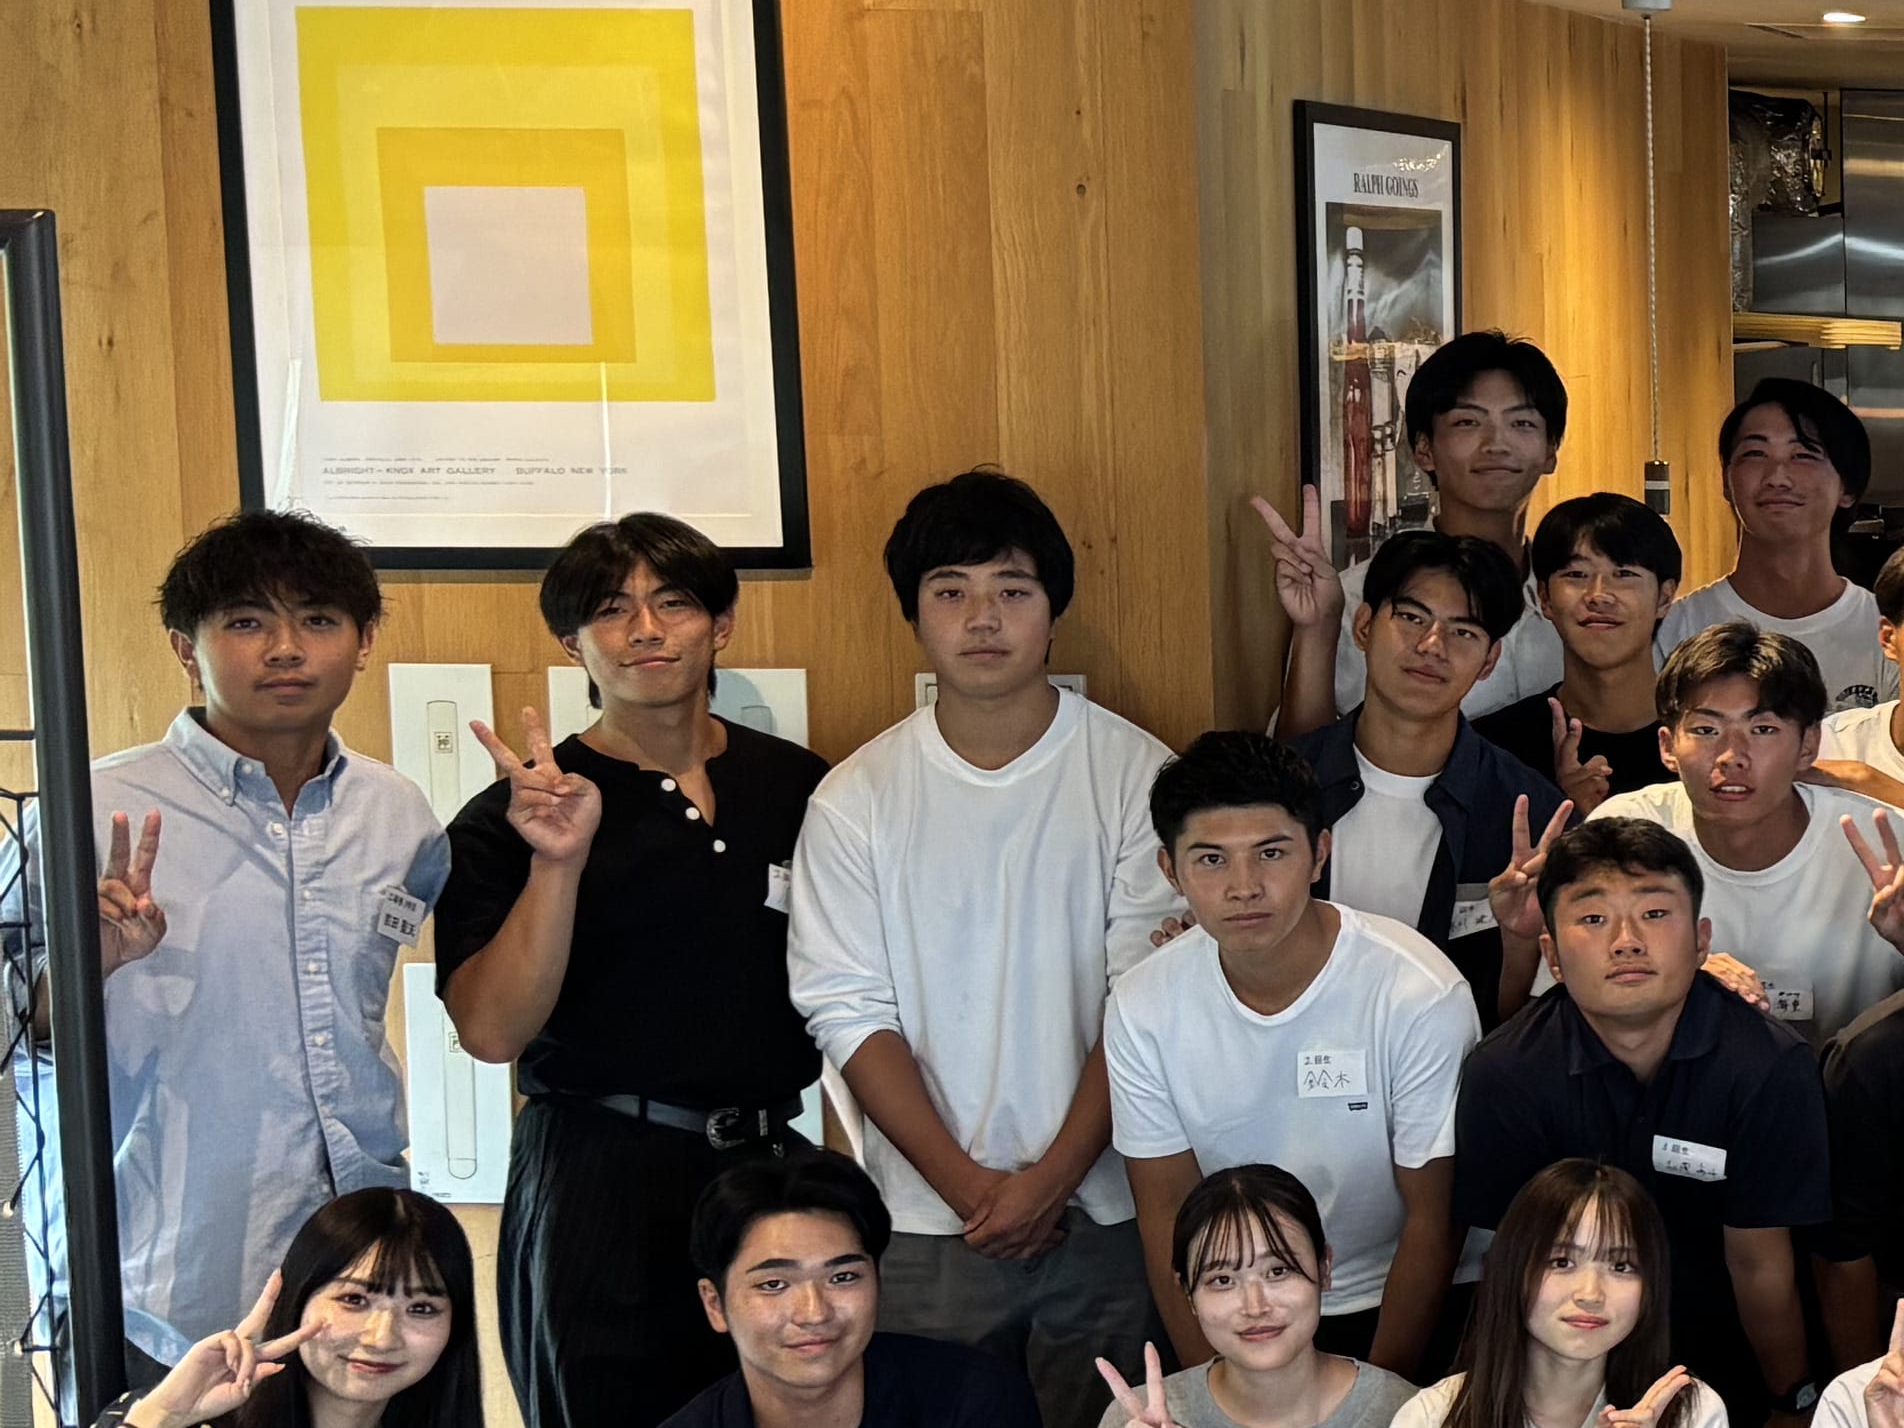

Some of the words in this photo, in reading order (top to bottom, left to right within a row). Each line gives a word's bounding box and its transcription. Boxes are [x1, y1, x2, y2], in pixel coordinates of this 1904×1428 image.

[1353, 172, 1384, 195] RALPH
[1385, 176, 1419, 199] GOINGS
[420, 466, 441, 476] ART
[446, 466, 496, 476] GALLERY
[516, 466, 566, 476] BUFFALO
[1304, 1069, 1351, 1091] 鈴木
